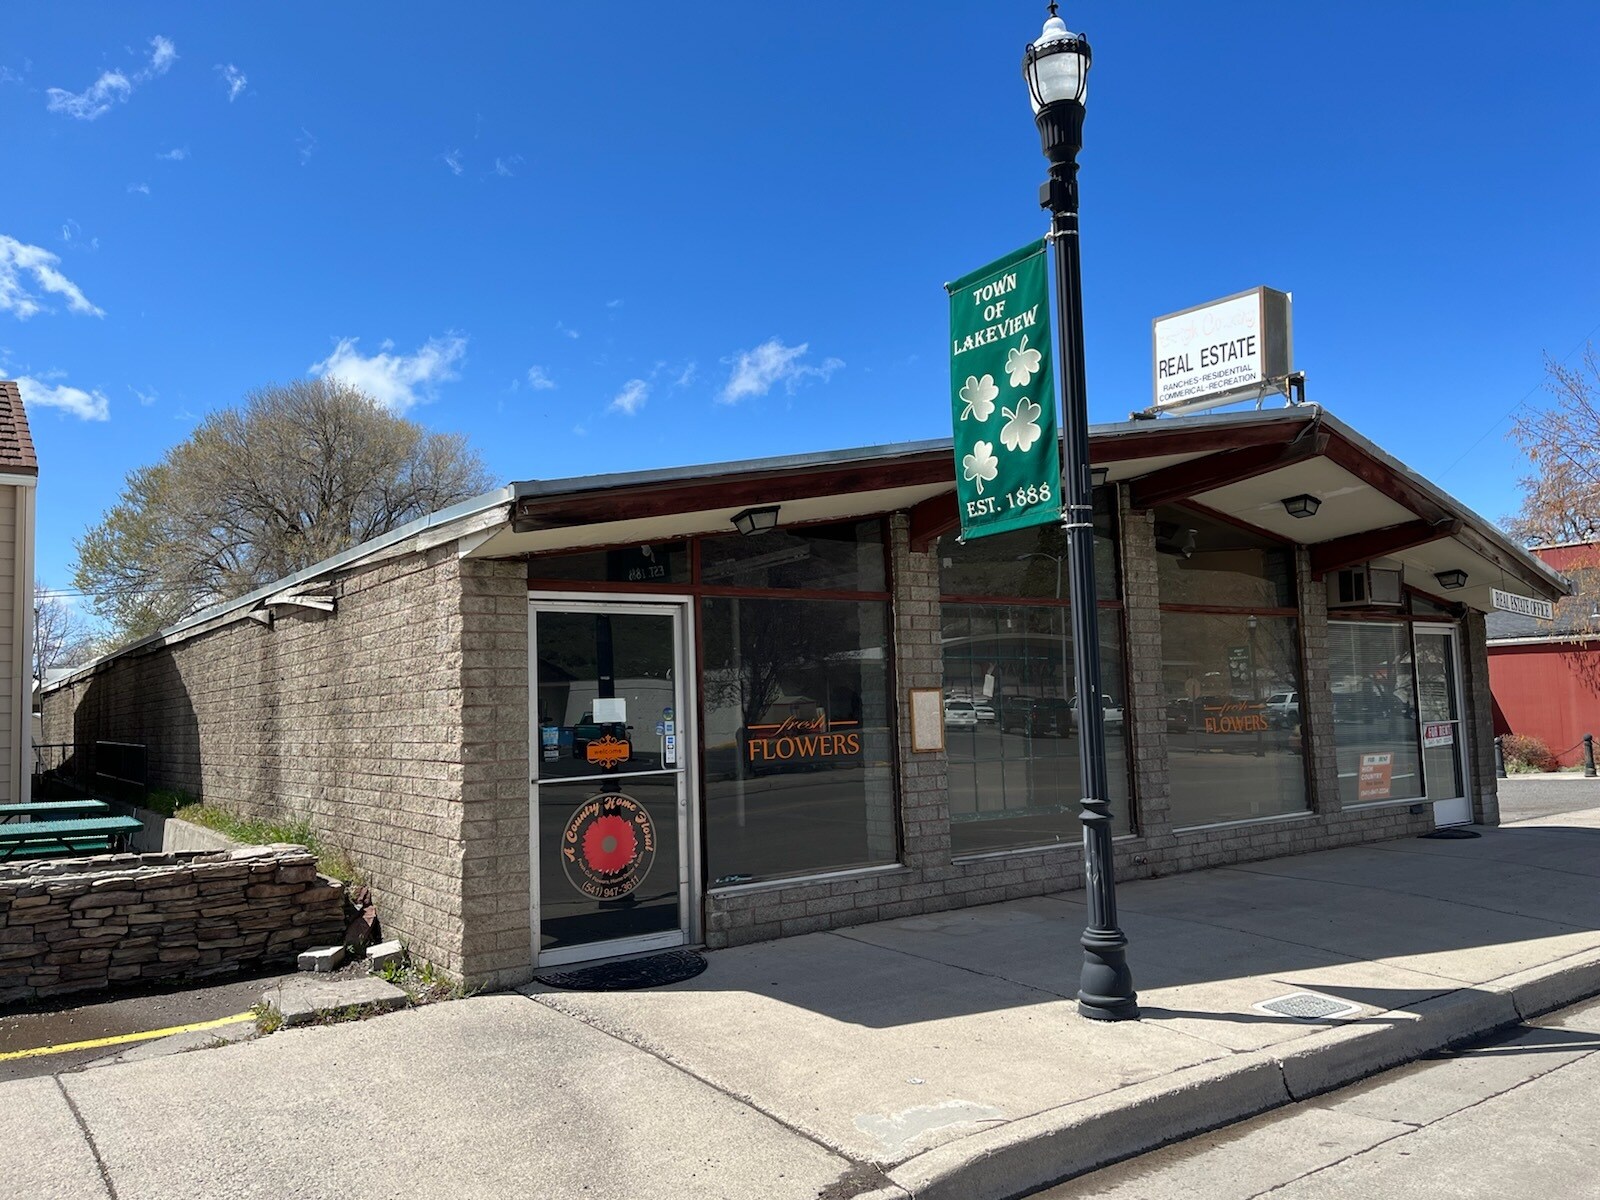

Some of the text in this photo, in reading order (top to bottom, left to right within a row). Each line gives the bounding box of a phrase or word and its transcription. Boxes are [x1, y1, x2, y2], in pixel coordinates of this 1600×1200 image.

[973, 273, 1017, 306] TOWN
[984, 300, 1006, 323] OF
[953, 304, 1039, 356] LAKEVIEW
[1159, 335, 1256, 380] REAL ESTATE
[966, 481, 1052, 518] EST. 1888
[1495, 591, 1550, 618] REAL ESTATE OFFICE
[771, 713, 827, 737] fresh
[1204, 714, 1269, 735] FLOWERS
[594, 747, 622, 756] welcome
[747, 733, 860, 762] FLOWERS
[563, 796, 653, 863] A Country Home Floral
[581, 880, 604, 897] (541)
